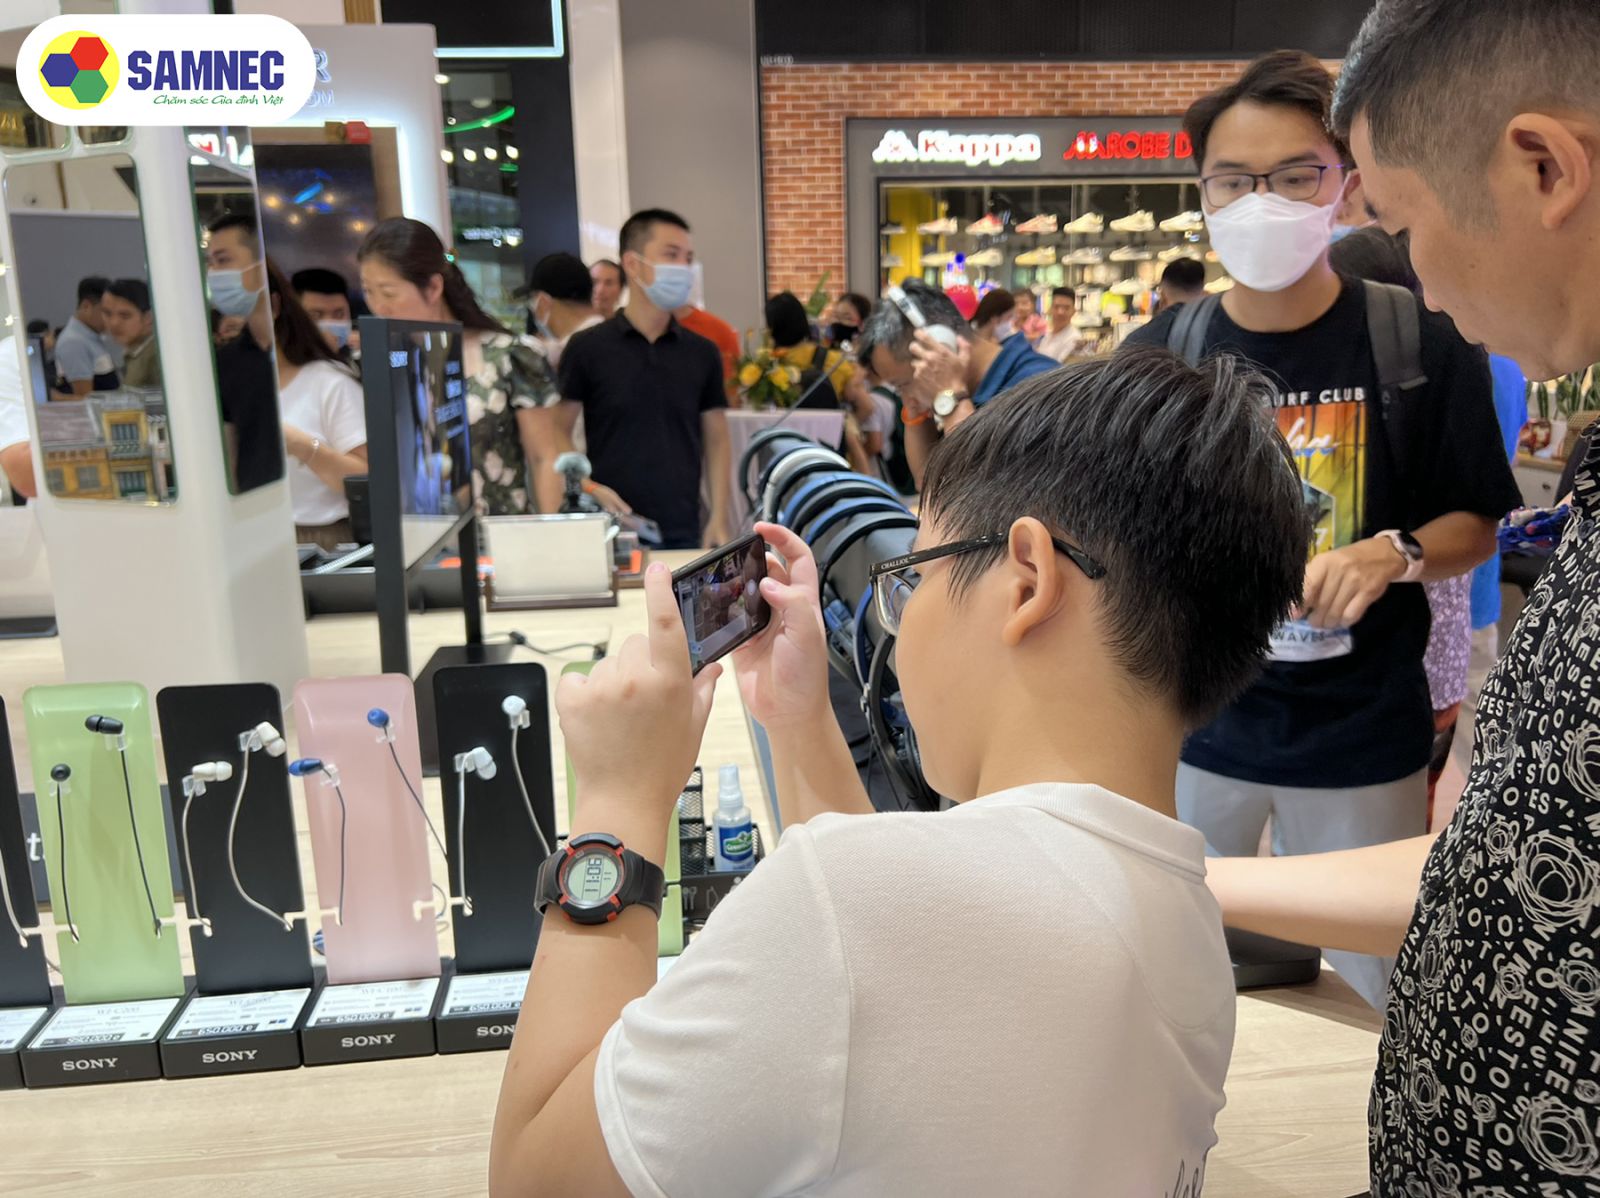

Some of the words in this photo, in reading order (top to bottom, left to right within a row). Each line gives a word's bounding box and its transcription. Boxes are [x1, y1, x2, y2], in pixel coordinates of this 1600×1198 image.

[918, 130, 1042, 166] Kappa
[1106, 131, 1170, 159] ROBE
[1318, 387, 1365, 404] CLUB
[476, 1024, 515, 1037] SON
[341, 1033, 396, 1048] SONY
[62, 1057, 119, 1071] SONY
[202, 1049, 258, 1064] SONY
